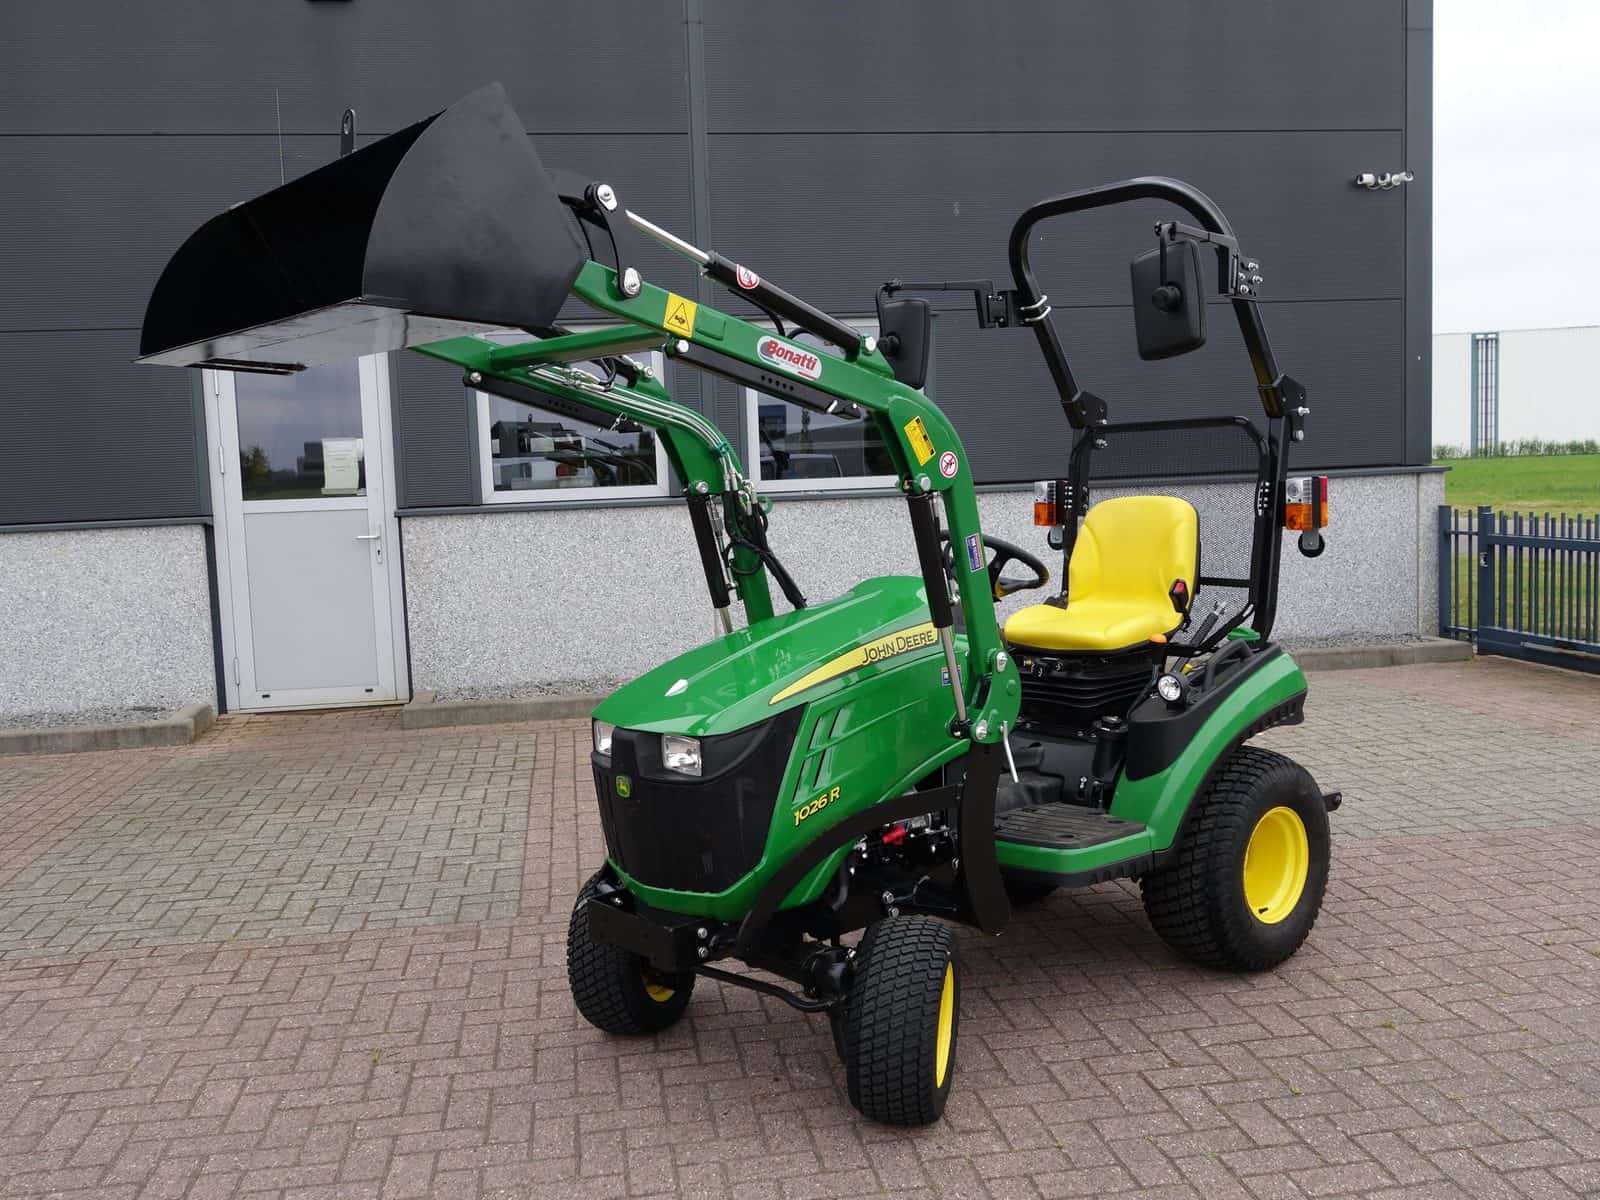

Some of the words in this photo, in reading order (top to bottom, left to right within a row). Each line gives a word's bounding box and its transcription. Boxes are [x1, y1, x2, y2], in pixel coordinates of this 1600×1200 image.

[765, 339, 818, 371] Bonatti
[862, 642, 895, 664] JOHN
[896, 630, 934, 651] DEERE
[794, 793, 828, 826] 1026
[830, 785, 841, 802] R
